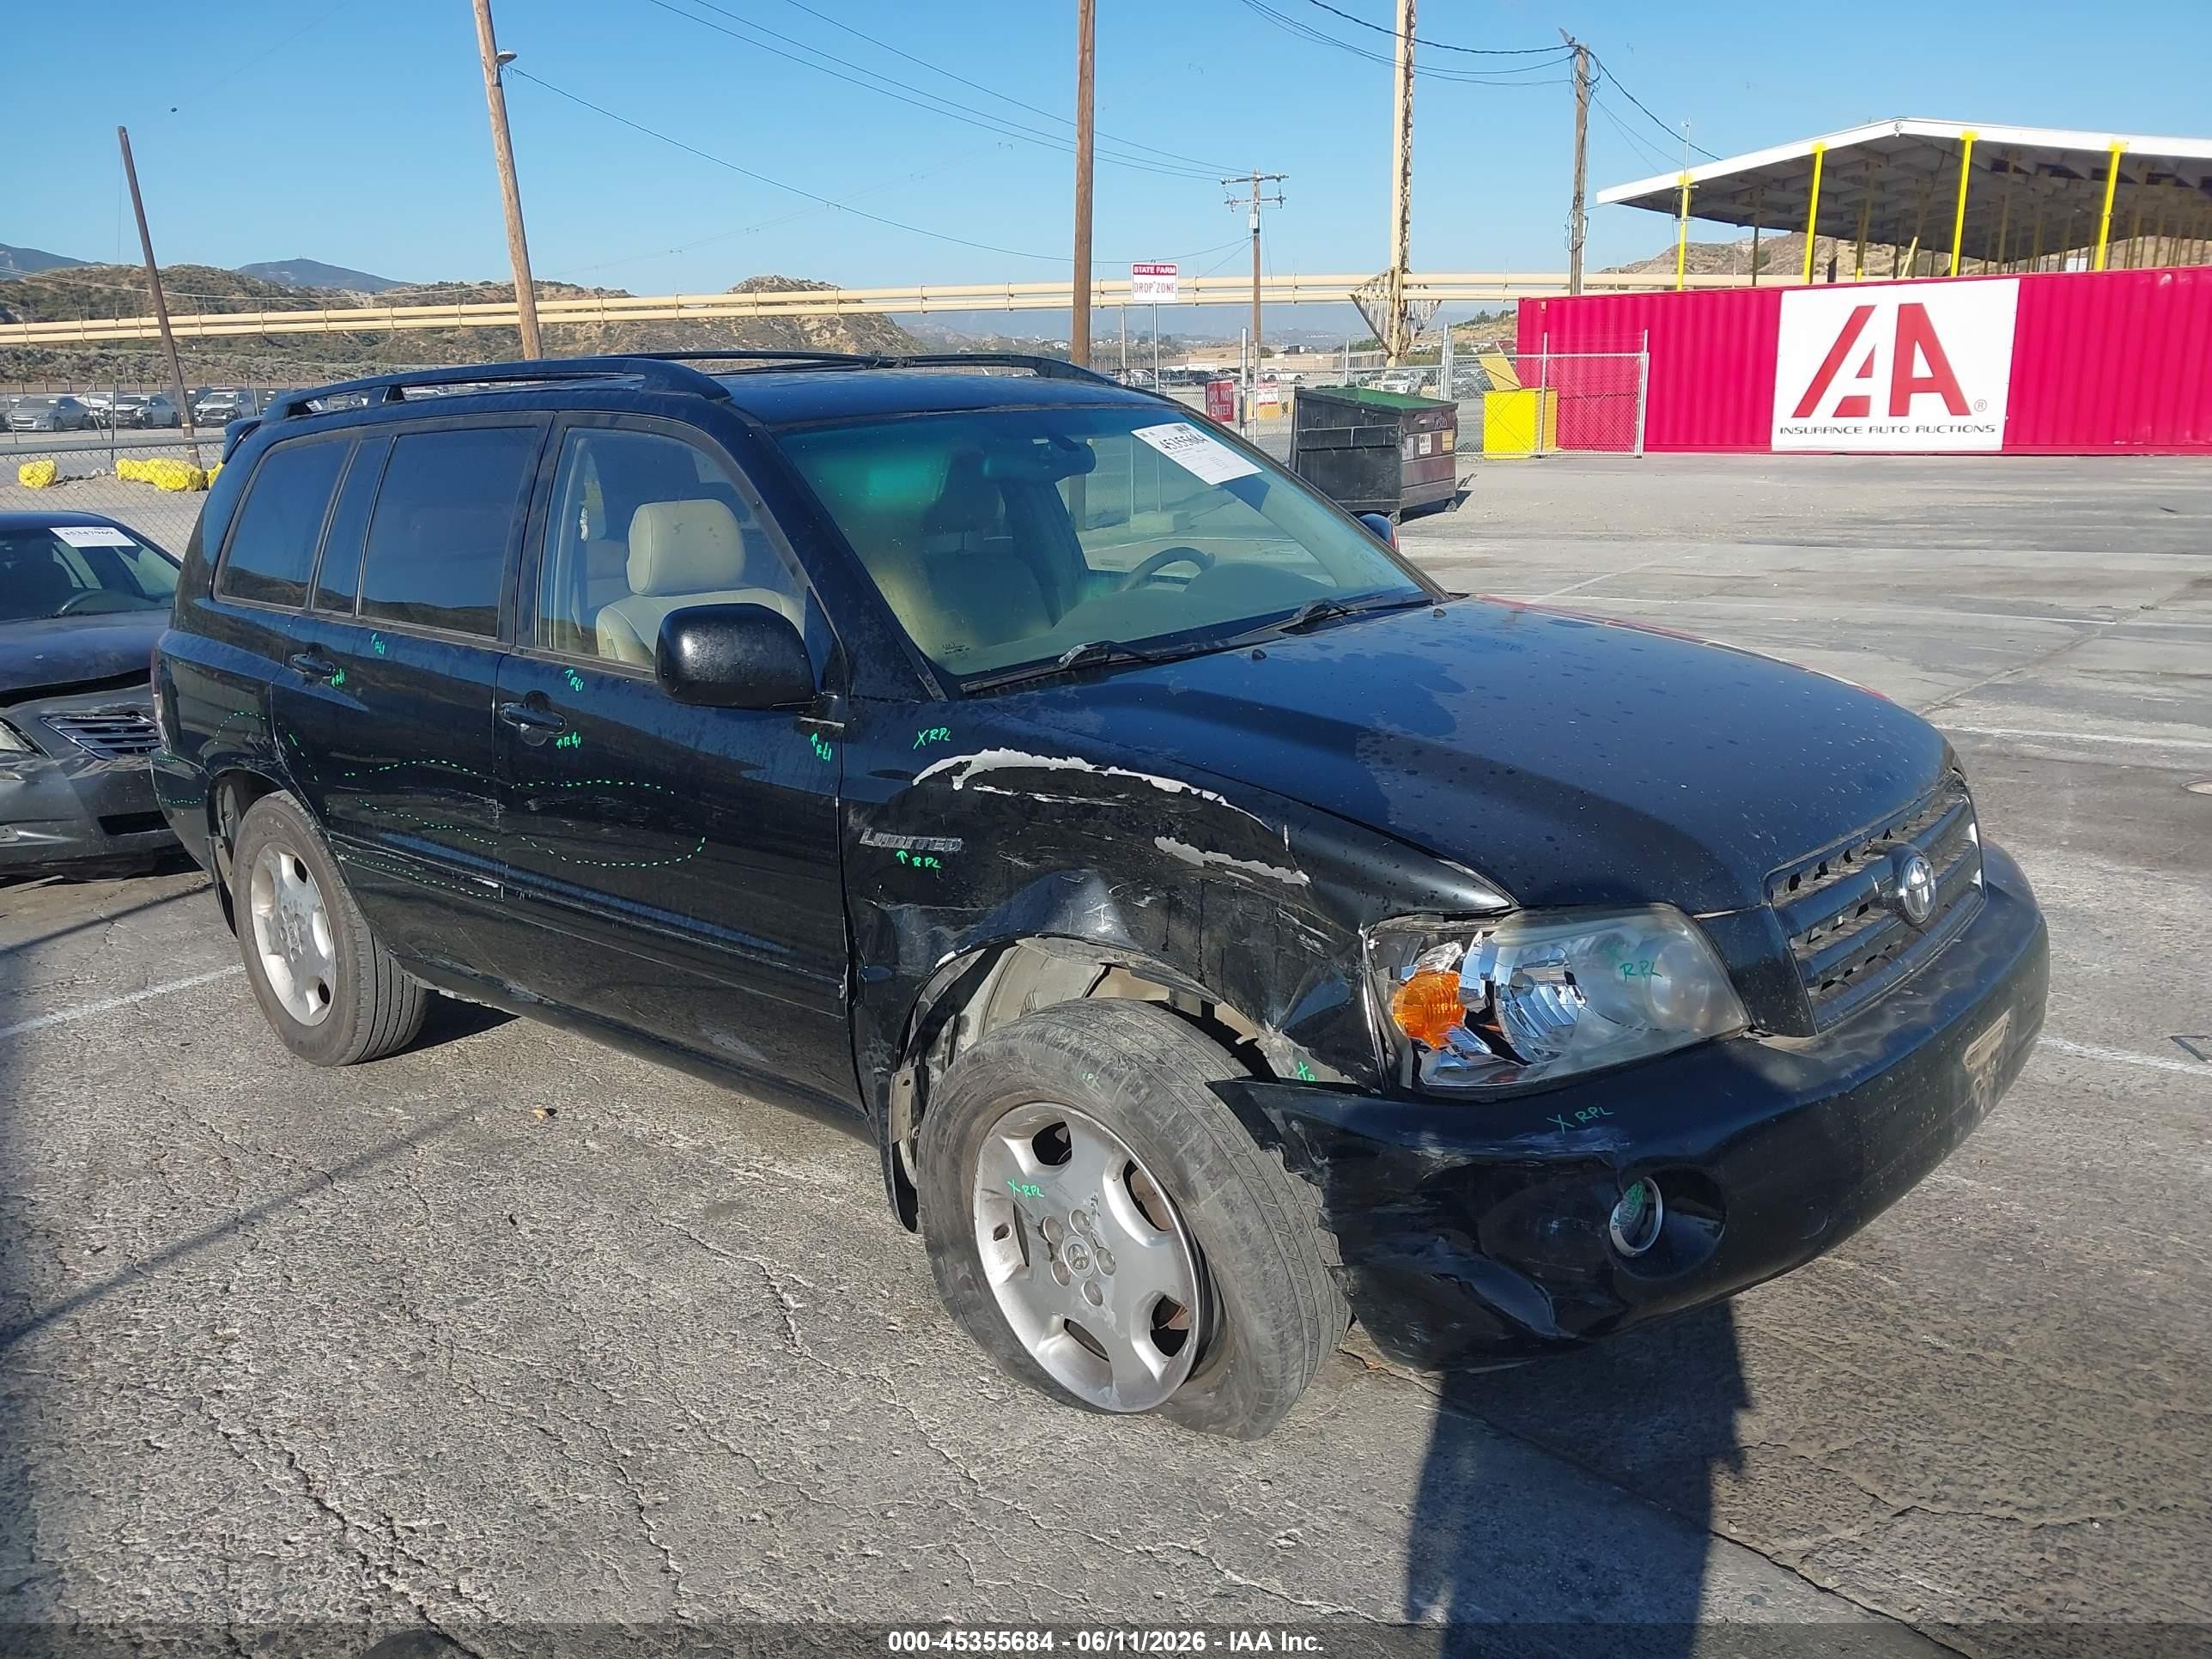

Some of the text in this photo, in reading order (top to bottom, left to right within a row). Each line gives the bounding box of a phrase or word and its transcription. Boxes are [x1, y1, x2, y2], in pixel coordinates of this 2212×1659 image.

[1133, 283, 1176, 294] DROP ZONE
[1209, 389, 1233, 403] DO NOT
[1211, 404, 1231, 417] ENTER
[1779, 424, 1996, 434] INSURANCE AUTO AUCTIONS
[859, 826, 964, 852] LIMITED
[912, 857, 942, 869] RPL
[1620, 960, 1663, 982] RPL
[1575, 1106, 1614, 1123] RPL
[1021, 1184, 1045, 1198] RPL
